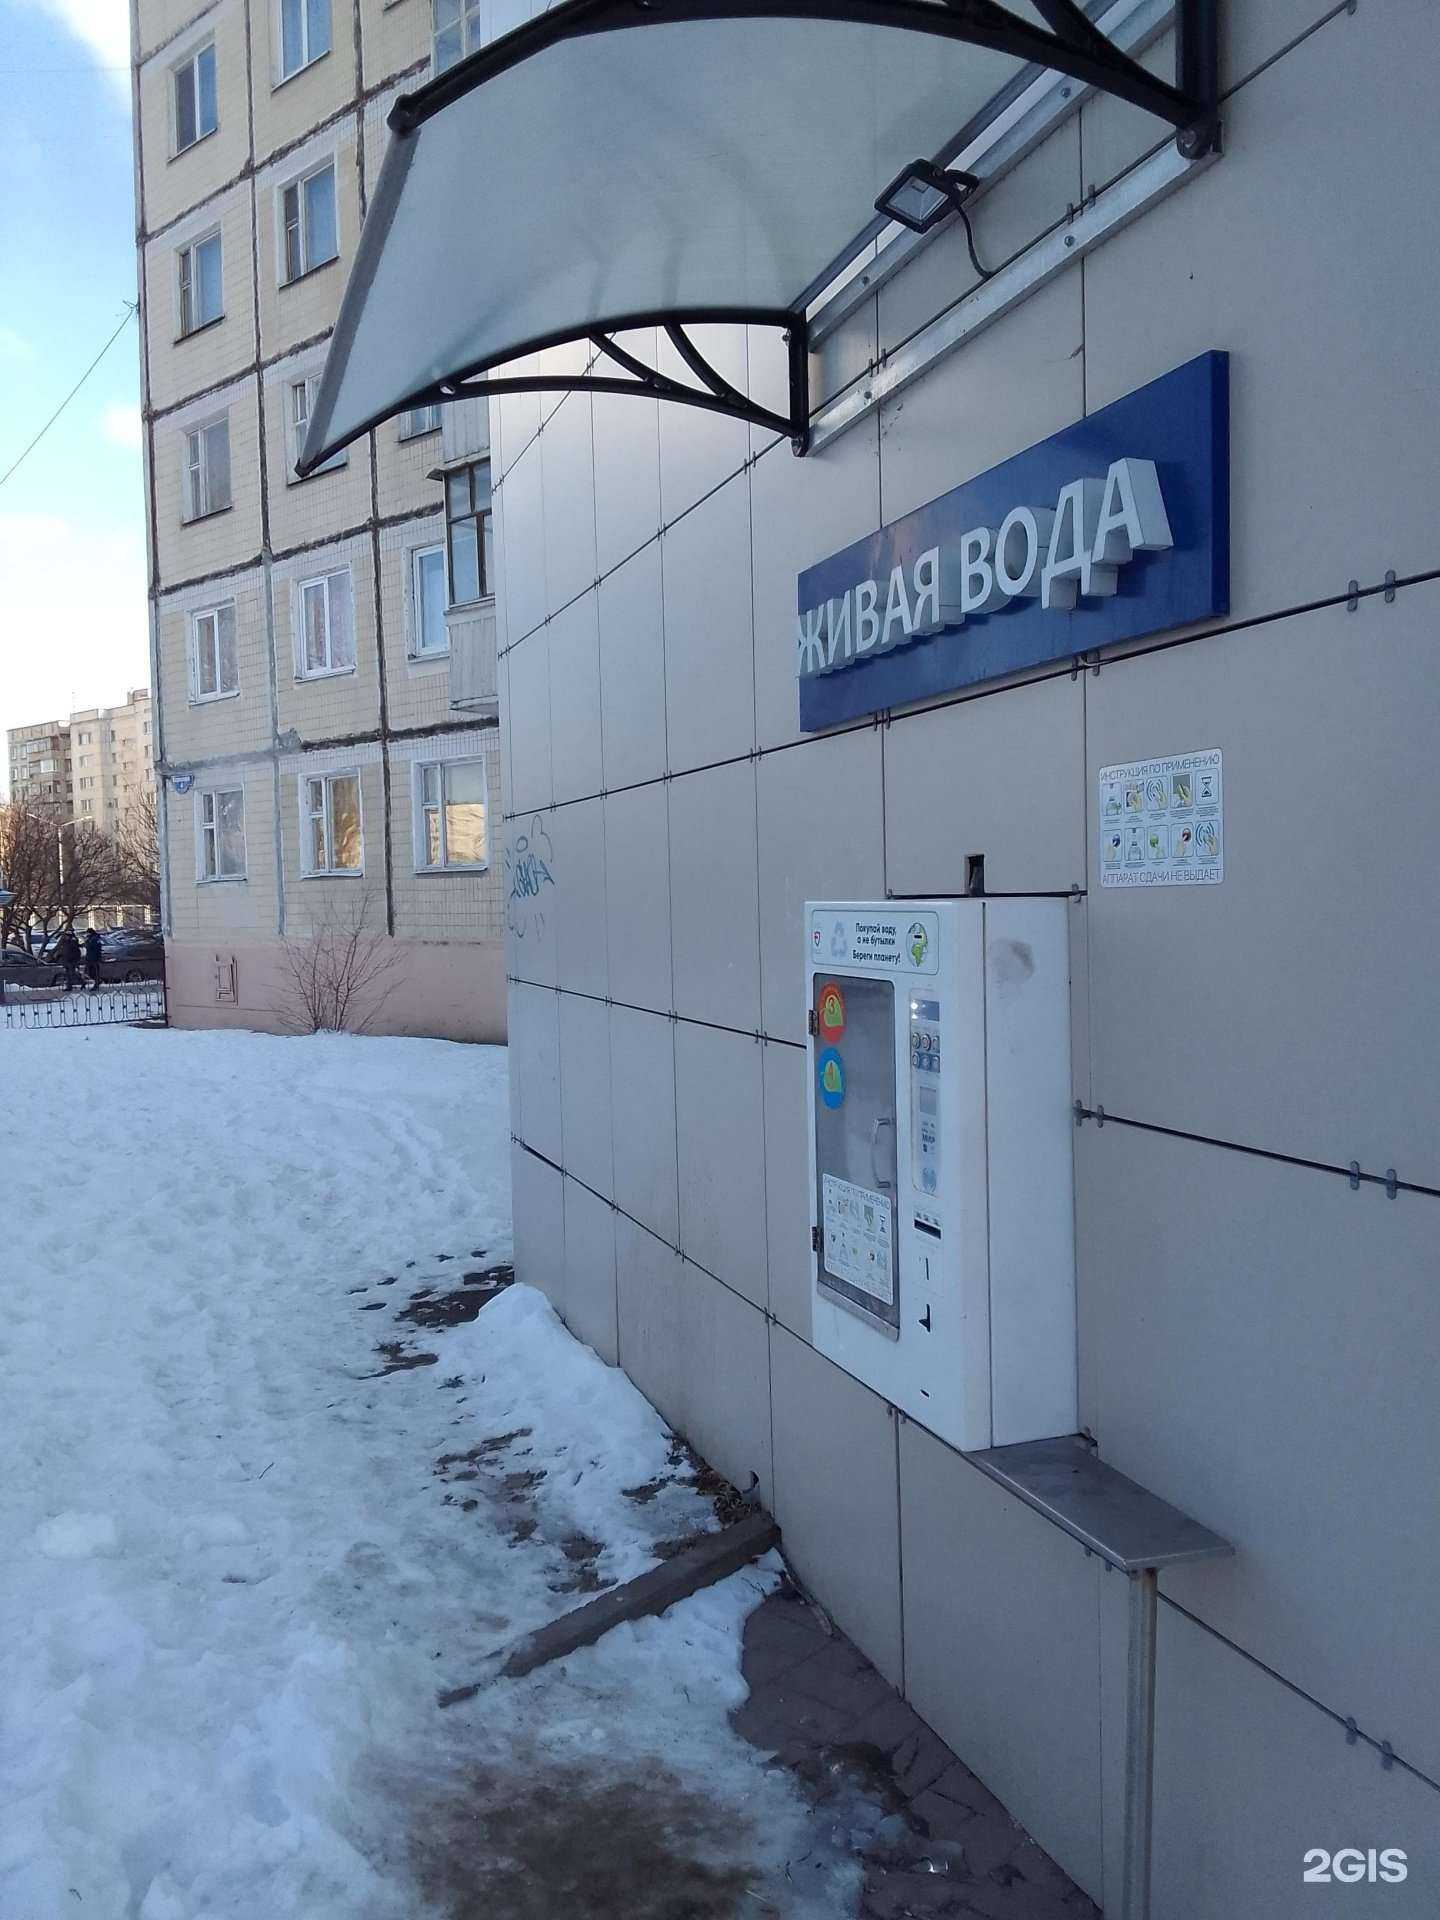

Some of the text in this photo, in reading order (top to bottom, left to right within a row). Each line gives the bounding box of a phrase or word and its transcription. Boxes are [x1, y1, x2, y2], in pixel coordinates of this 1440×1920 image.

[797, 457, 1152, 674] ЖИВАЯ ВОДА
[870, 935, 896, 947] бутылки
[852, 949, 873, 961] Береги
